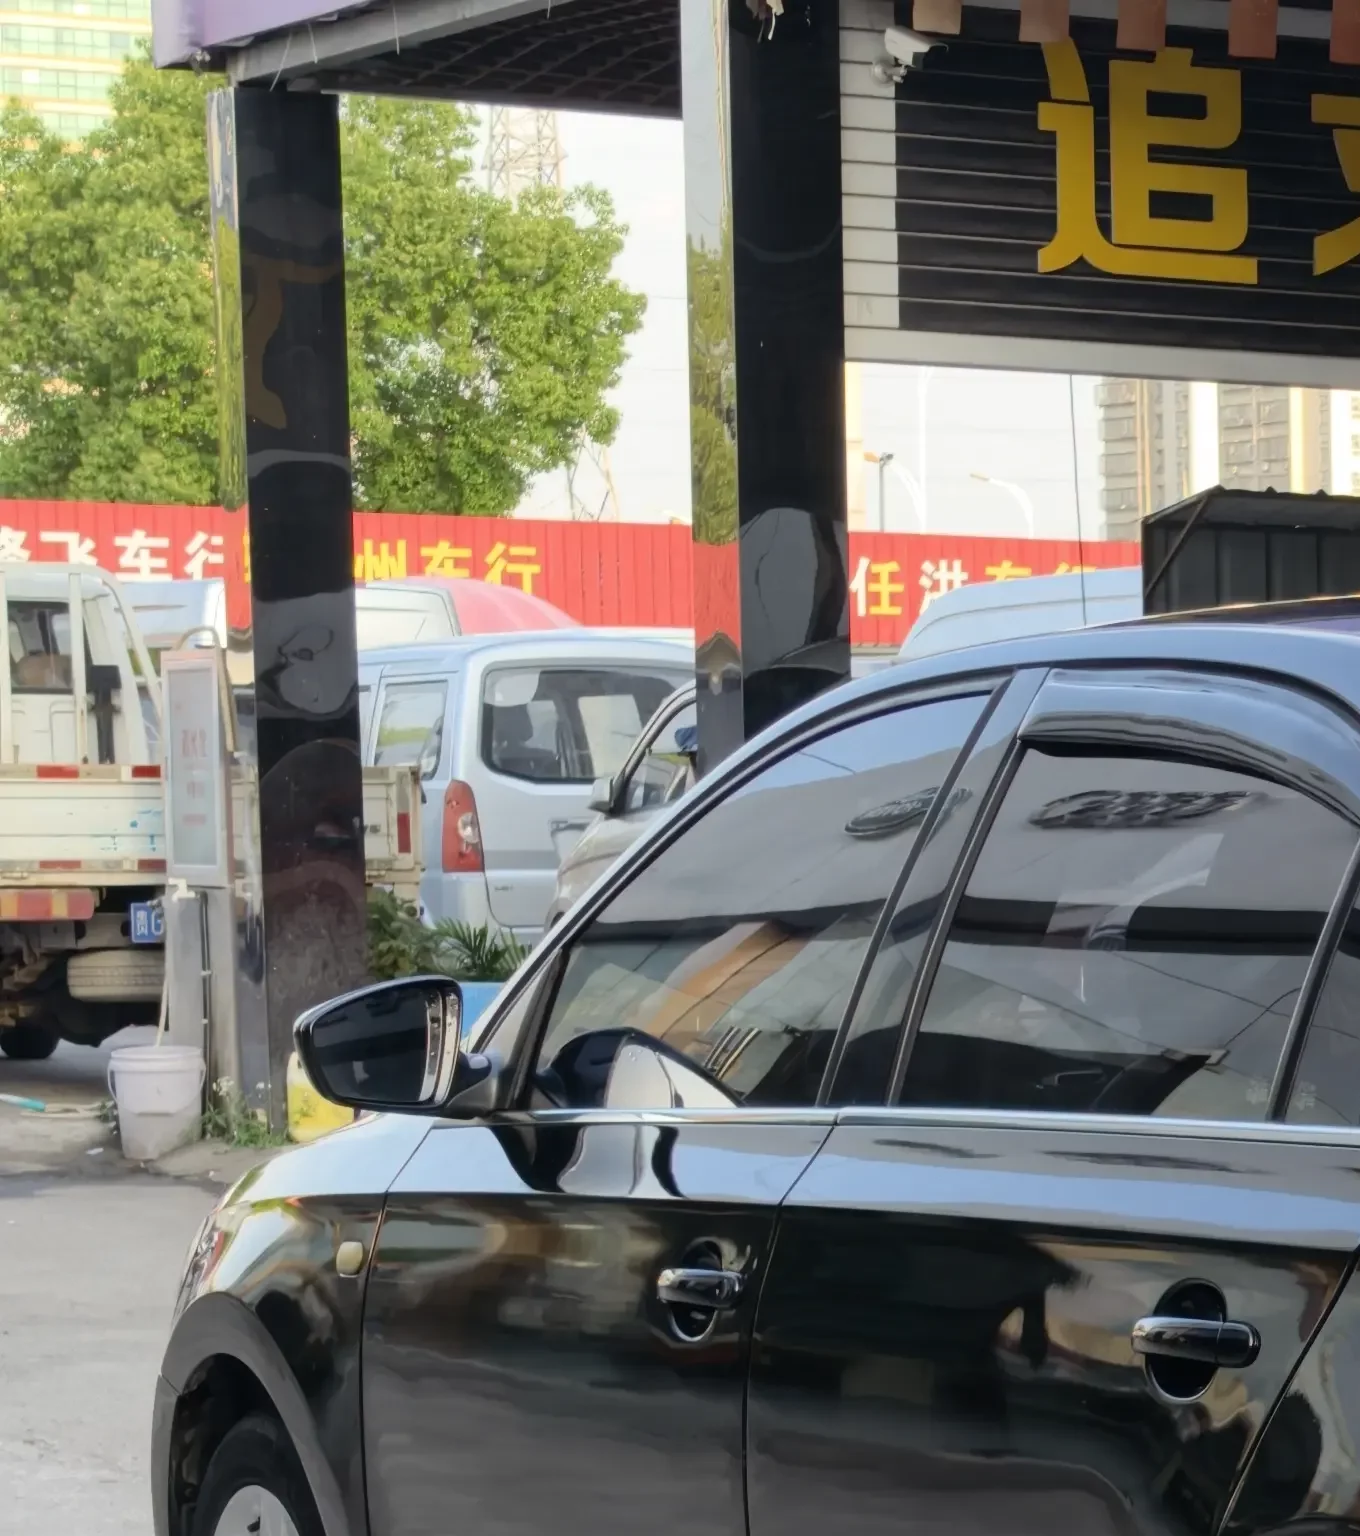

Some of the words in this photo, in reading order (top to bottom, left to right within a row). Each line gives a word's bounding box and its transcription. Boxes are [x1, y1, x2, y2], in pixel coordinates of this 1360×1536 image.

[242, 536, 543, 595] 州车行
[849, 556, 1097, 618] 任洪
